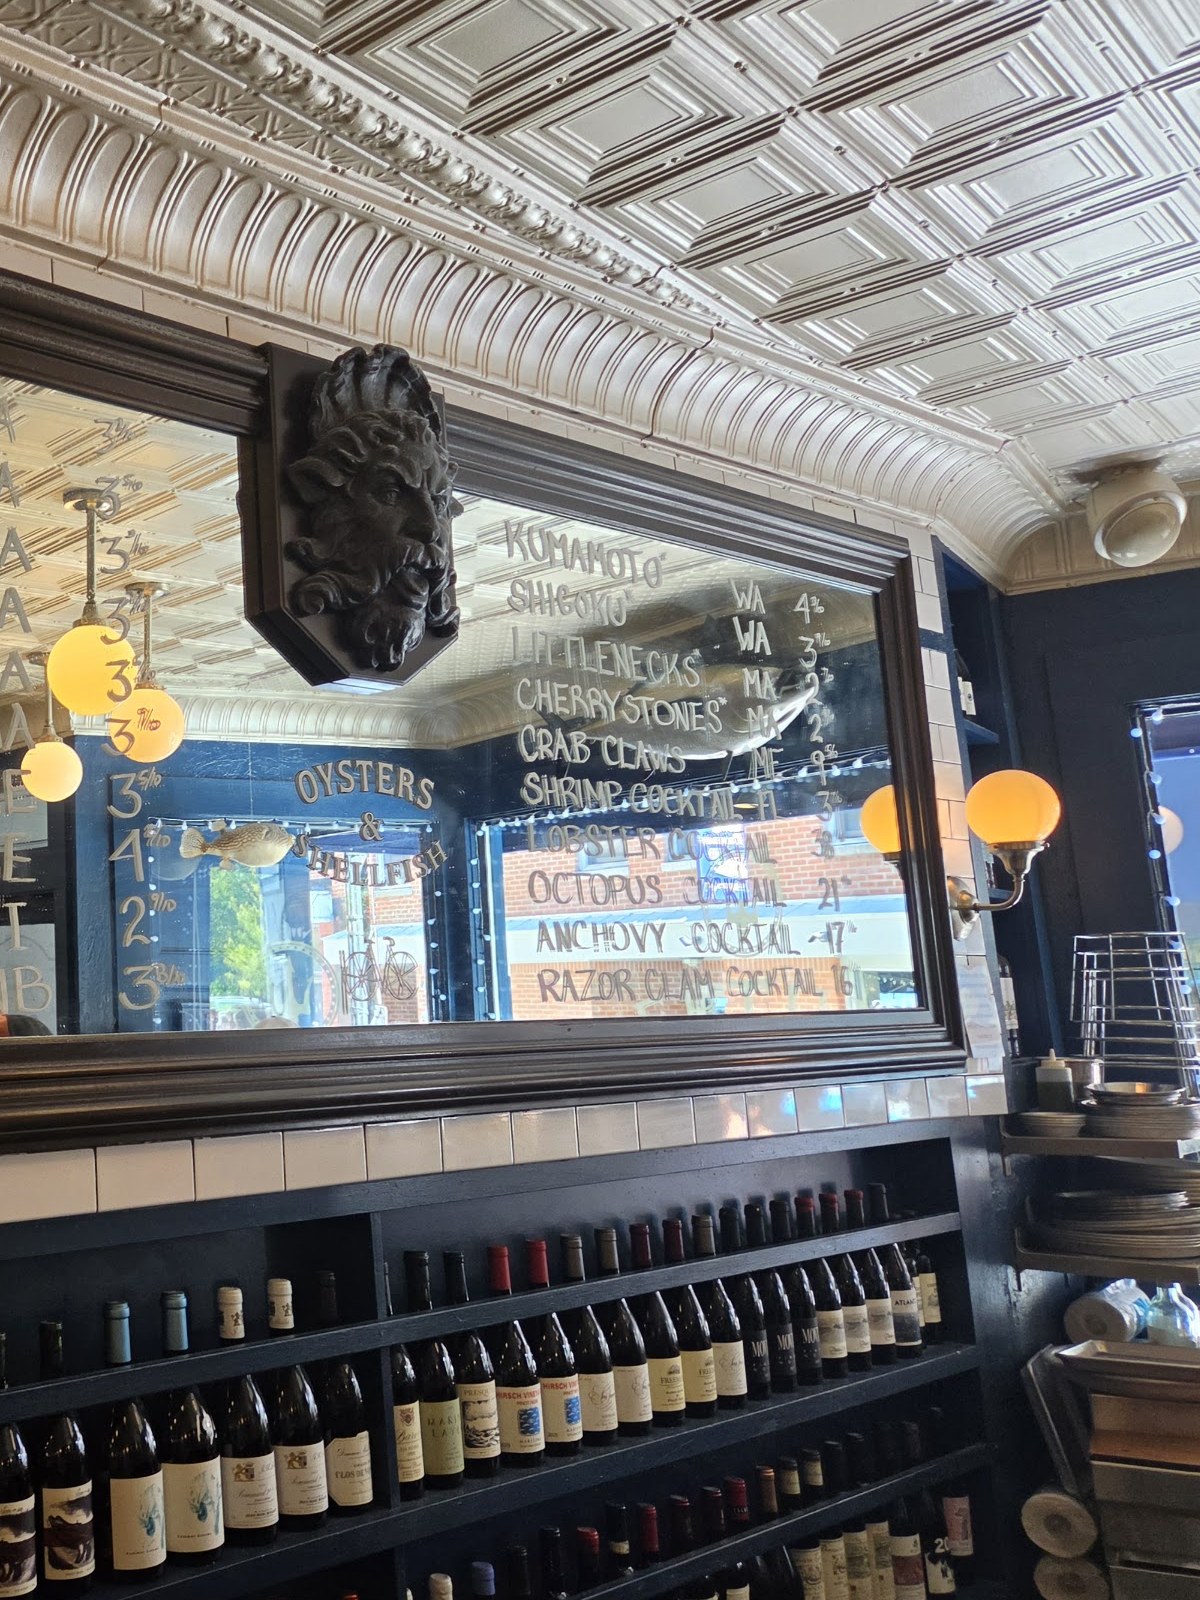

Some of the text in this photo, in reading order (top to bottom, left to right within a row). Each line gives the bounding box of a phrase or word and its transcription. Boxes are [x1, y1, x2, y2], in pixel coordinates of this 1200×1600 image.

[730, 577, 766, 615] WA
[732, 615, 772, 656] WA
[742, 667, 778, 701] MA
[518, 723, 591, 764] CRAB
[601, 734, 687, 775] CLAWS
[294, 759, 435, 810] OYSTERS
[520, 771, 623, 811] SHRIMP
[630, 782, 743, 821] COCKTAIL
[358, 811, 384, 842] &
[527, 822, 662, 860] LOBSTER
[291, 834, 449, 888] SHELLFISH
[527, 870, 663, 906] OCTOPUS
[536, 919, 667, 953] ANCHOVY
[691, 921, 801, 956] COCKTAIL
[537, 968, 635, 1004] RAZOR
[644, 968, 716, 1001] CLAM
[726, 965, 824, 997] COCKTAIL
